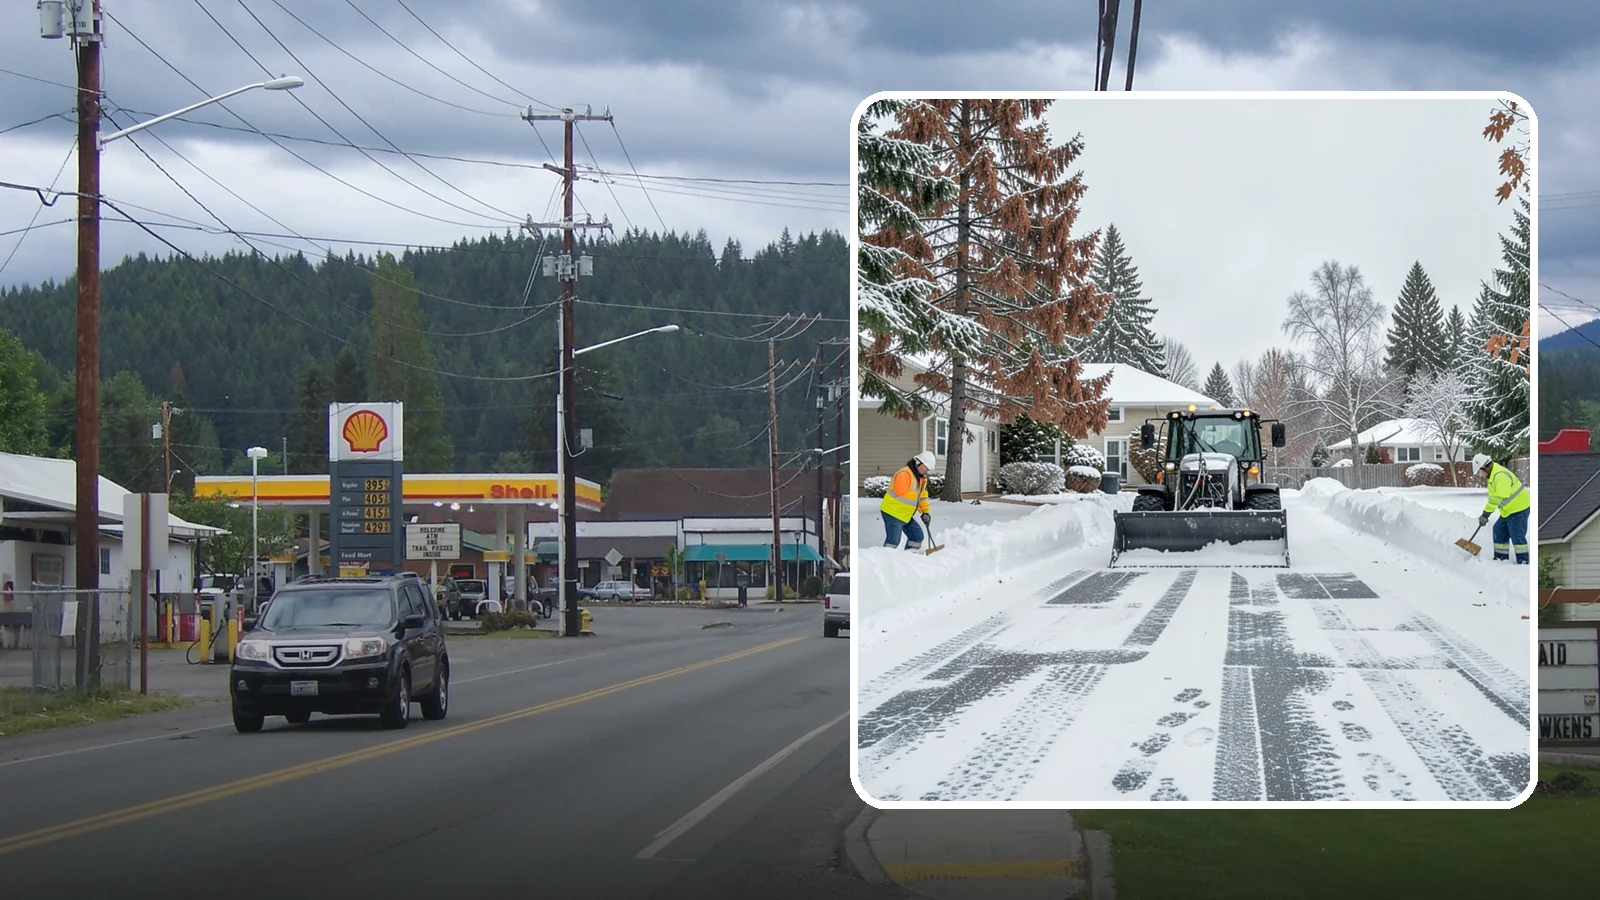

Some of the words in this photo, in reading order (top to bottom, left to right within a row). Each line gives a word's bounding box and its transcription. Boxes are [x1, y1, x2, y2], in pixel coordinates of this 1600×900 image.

[365, 480, 383, 490] 395
[490, 484, 547, 499] Shell
[365, 494, 383, 504] 405
[365, 508, 383, 518] 415
[365, 522, 383, 533] 429
